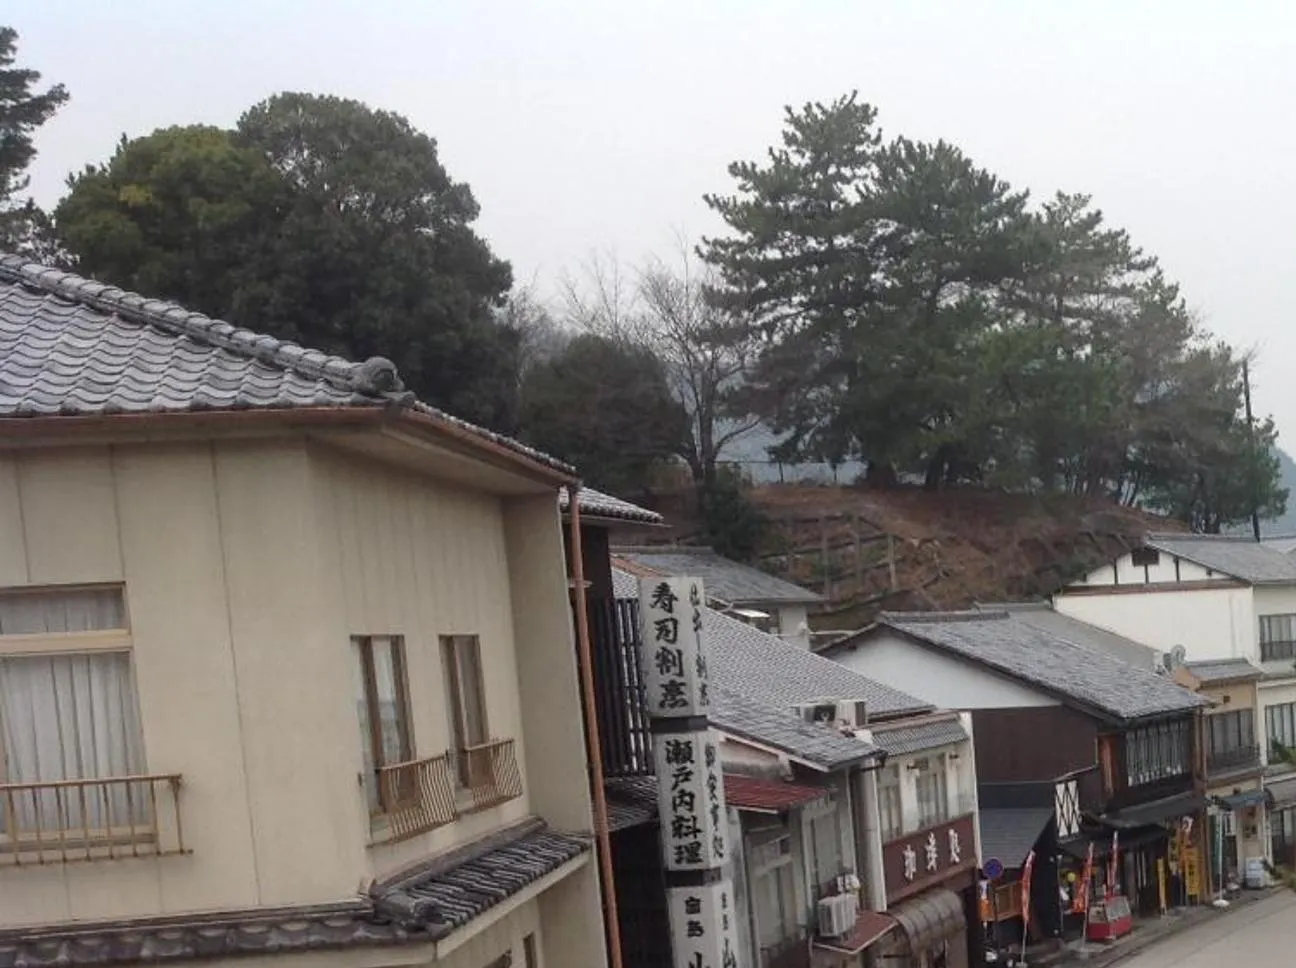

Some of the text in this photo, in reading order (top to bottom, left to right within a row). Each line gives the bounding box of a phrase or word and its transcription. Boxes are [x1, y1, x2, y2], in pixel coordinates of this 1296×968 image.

[649, 581, 689, 709] 寿司割烹
[664, 738, 704, 865] 瀬戸内料理
